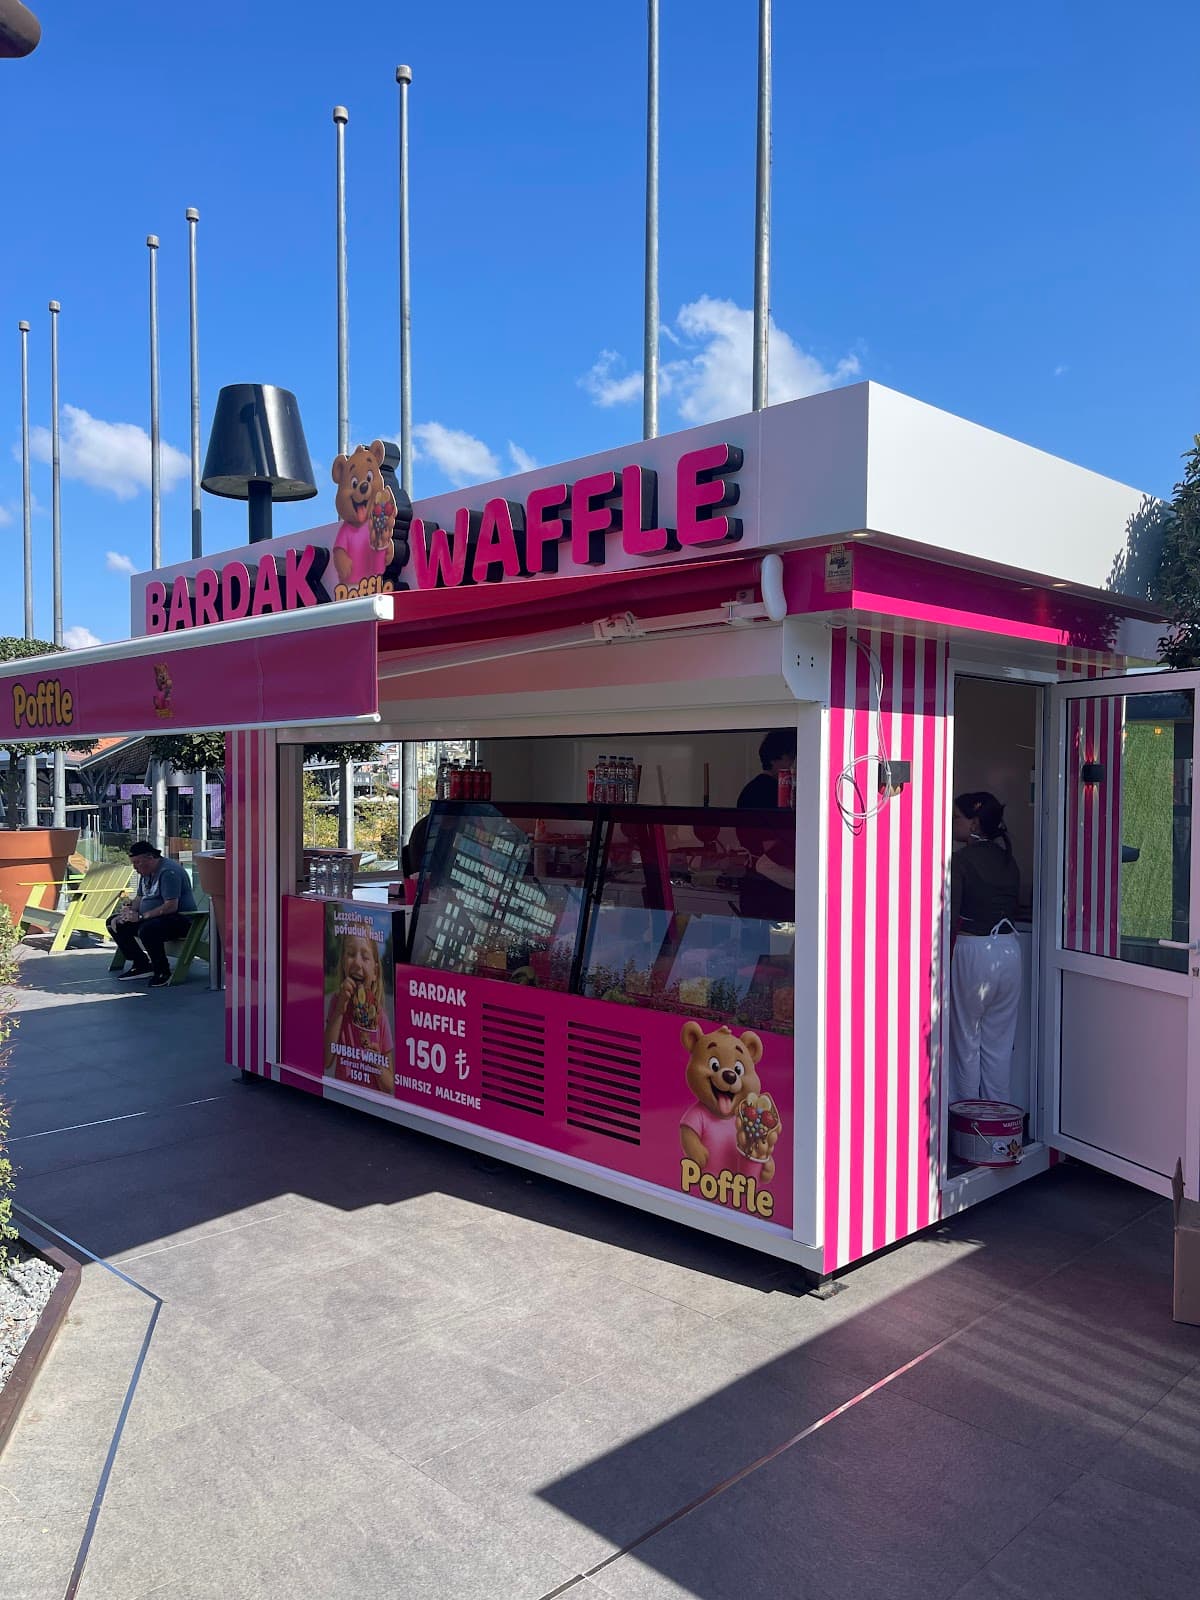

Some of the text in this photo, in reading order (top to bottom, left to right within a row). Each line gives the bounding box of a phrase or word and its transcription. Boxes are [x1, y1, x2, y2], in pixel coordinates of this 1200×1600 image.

[145, 442, 740, 634] BARDAK WAFFLE
[12, 678, 74, 729] Poffle
[364, 915, 374, 925] en
[408, 979, 467, 1007] BARDAK
[410, 1008, 466, 1038] WAFFLE
[330, 1042, 390, 1068] BUBBLE WAFFLE
[406, 1037, 447, 1074] 150
[350, 1069, 371, 1084] 150 TL
[394, 1073, 481, 1110] SINIRSIZ MALZEME
[680, 1157, 775, 1218] Poffle
